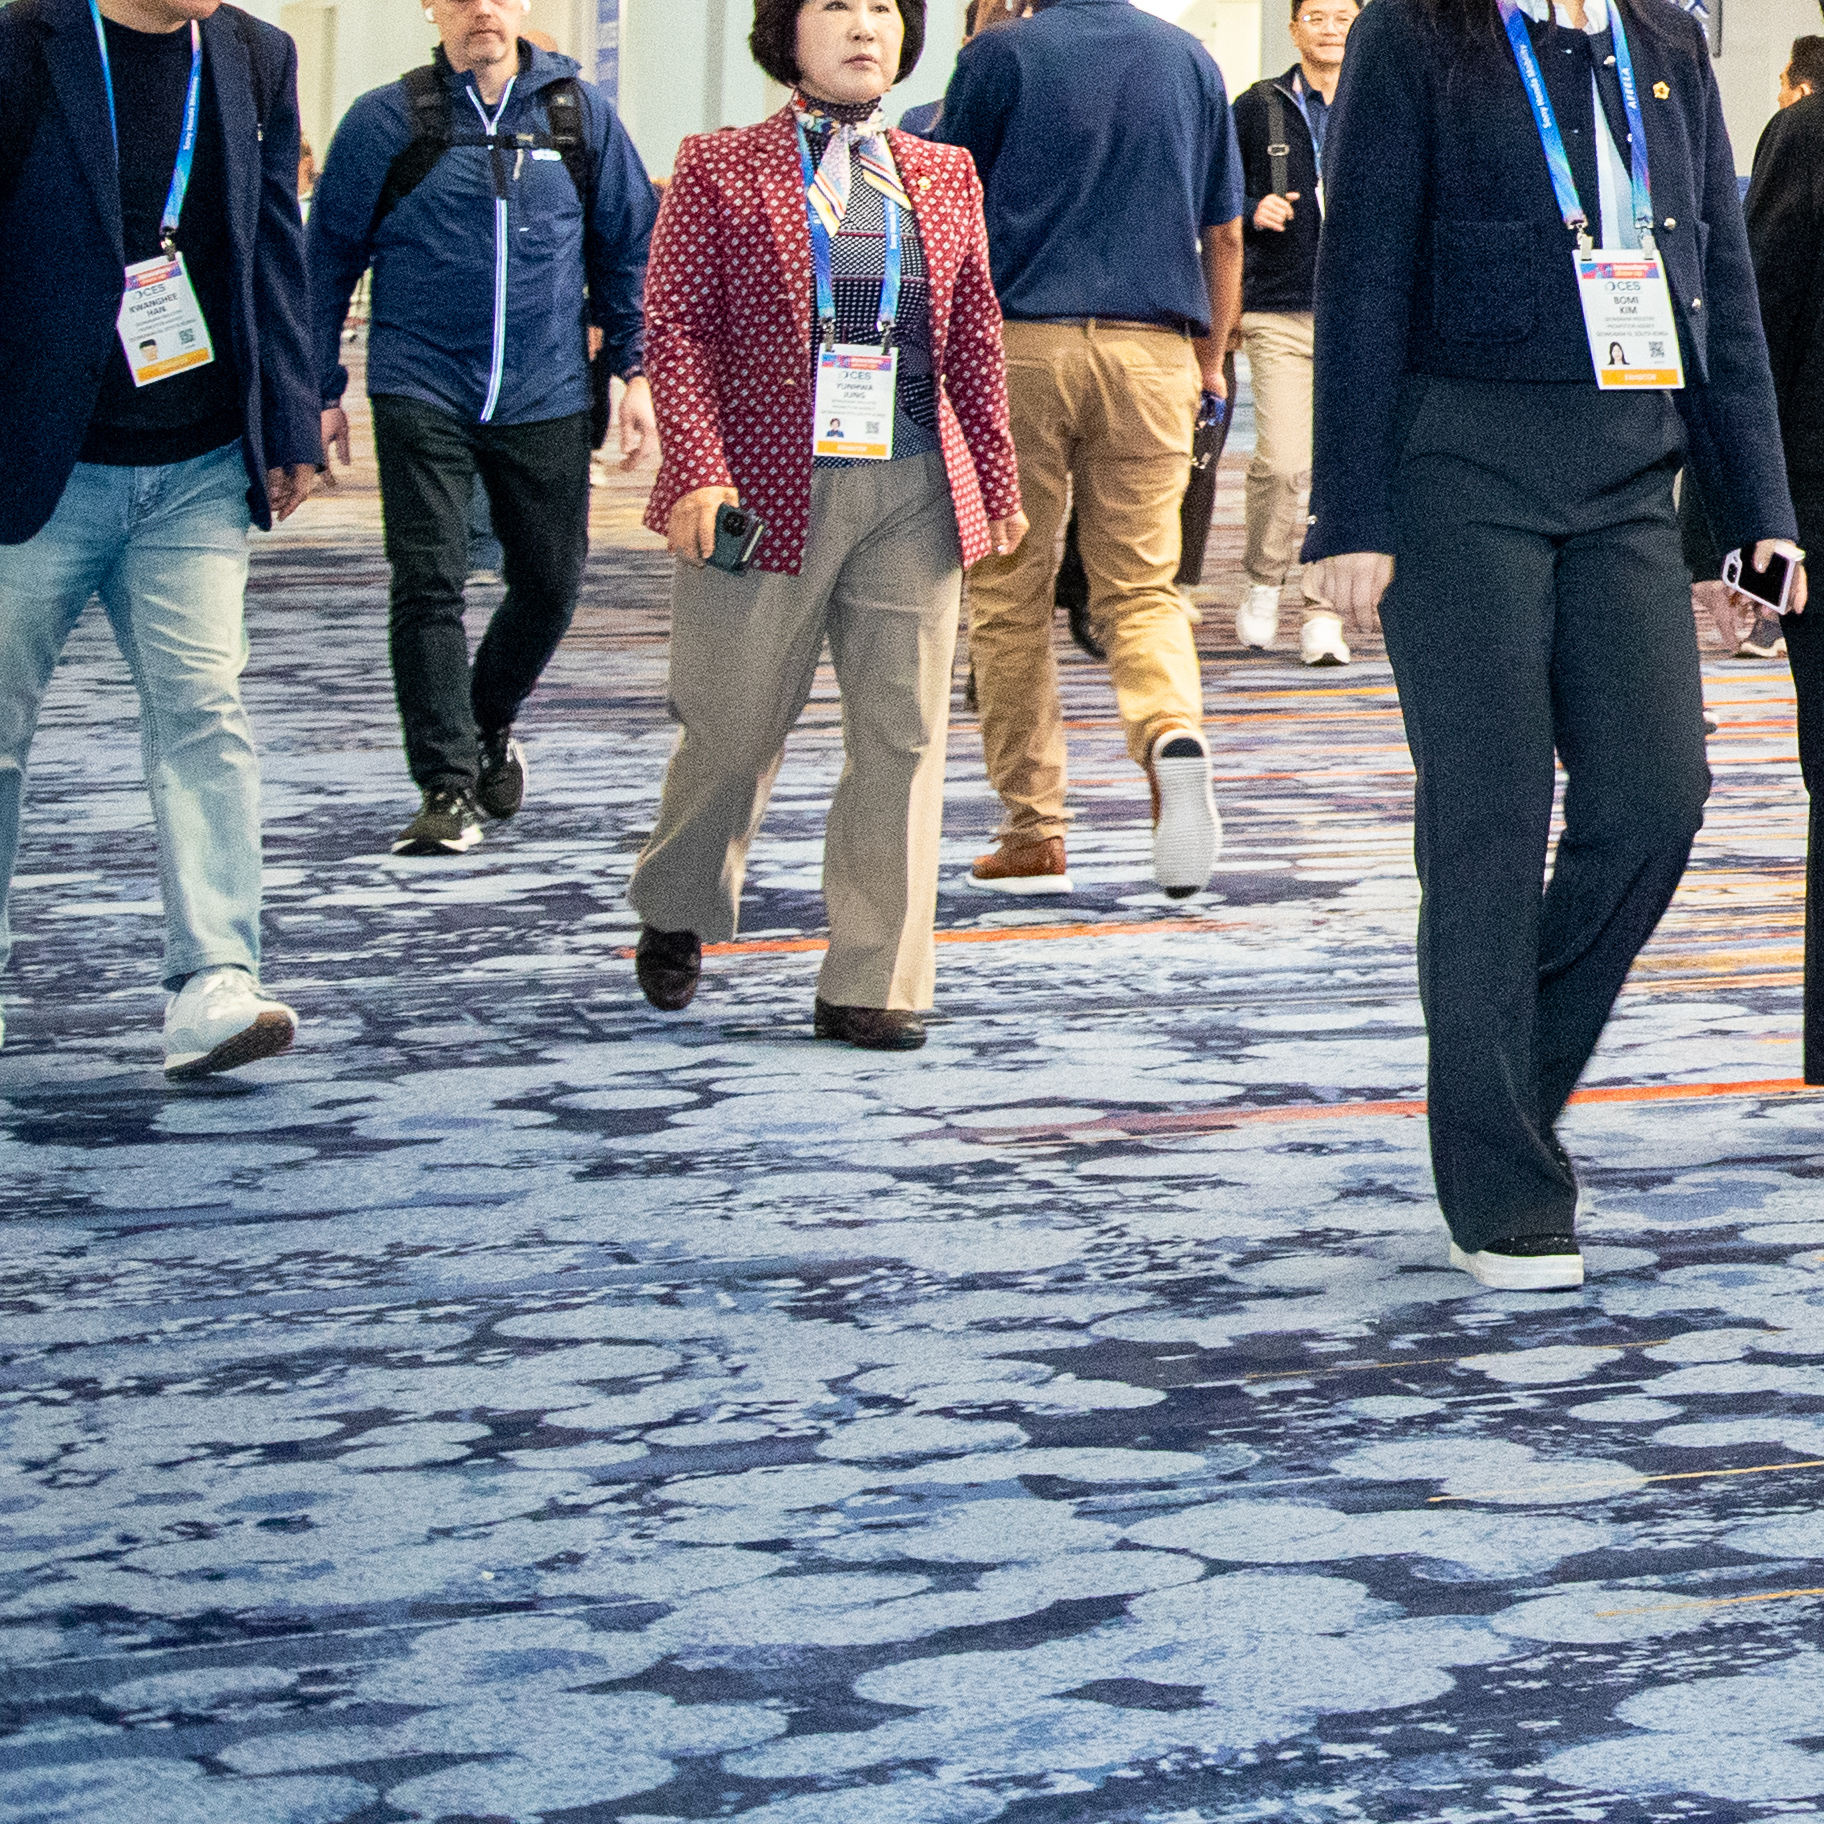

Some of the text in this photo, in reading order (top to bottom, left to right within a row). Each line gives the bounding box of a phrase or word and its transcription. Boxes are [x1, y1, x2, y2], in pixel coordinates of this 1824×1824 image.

[143, 283, 166, 297] CES
[1617, 281, 1641, 291] CES
[1620, 306, 1638, 314] KIM
[849, 371, 872, 381] CES
